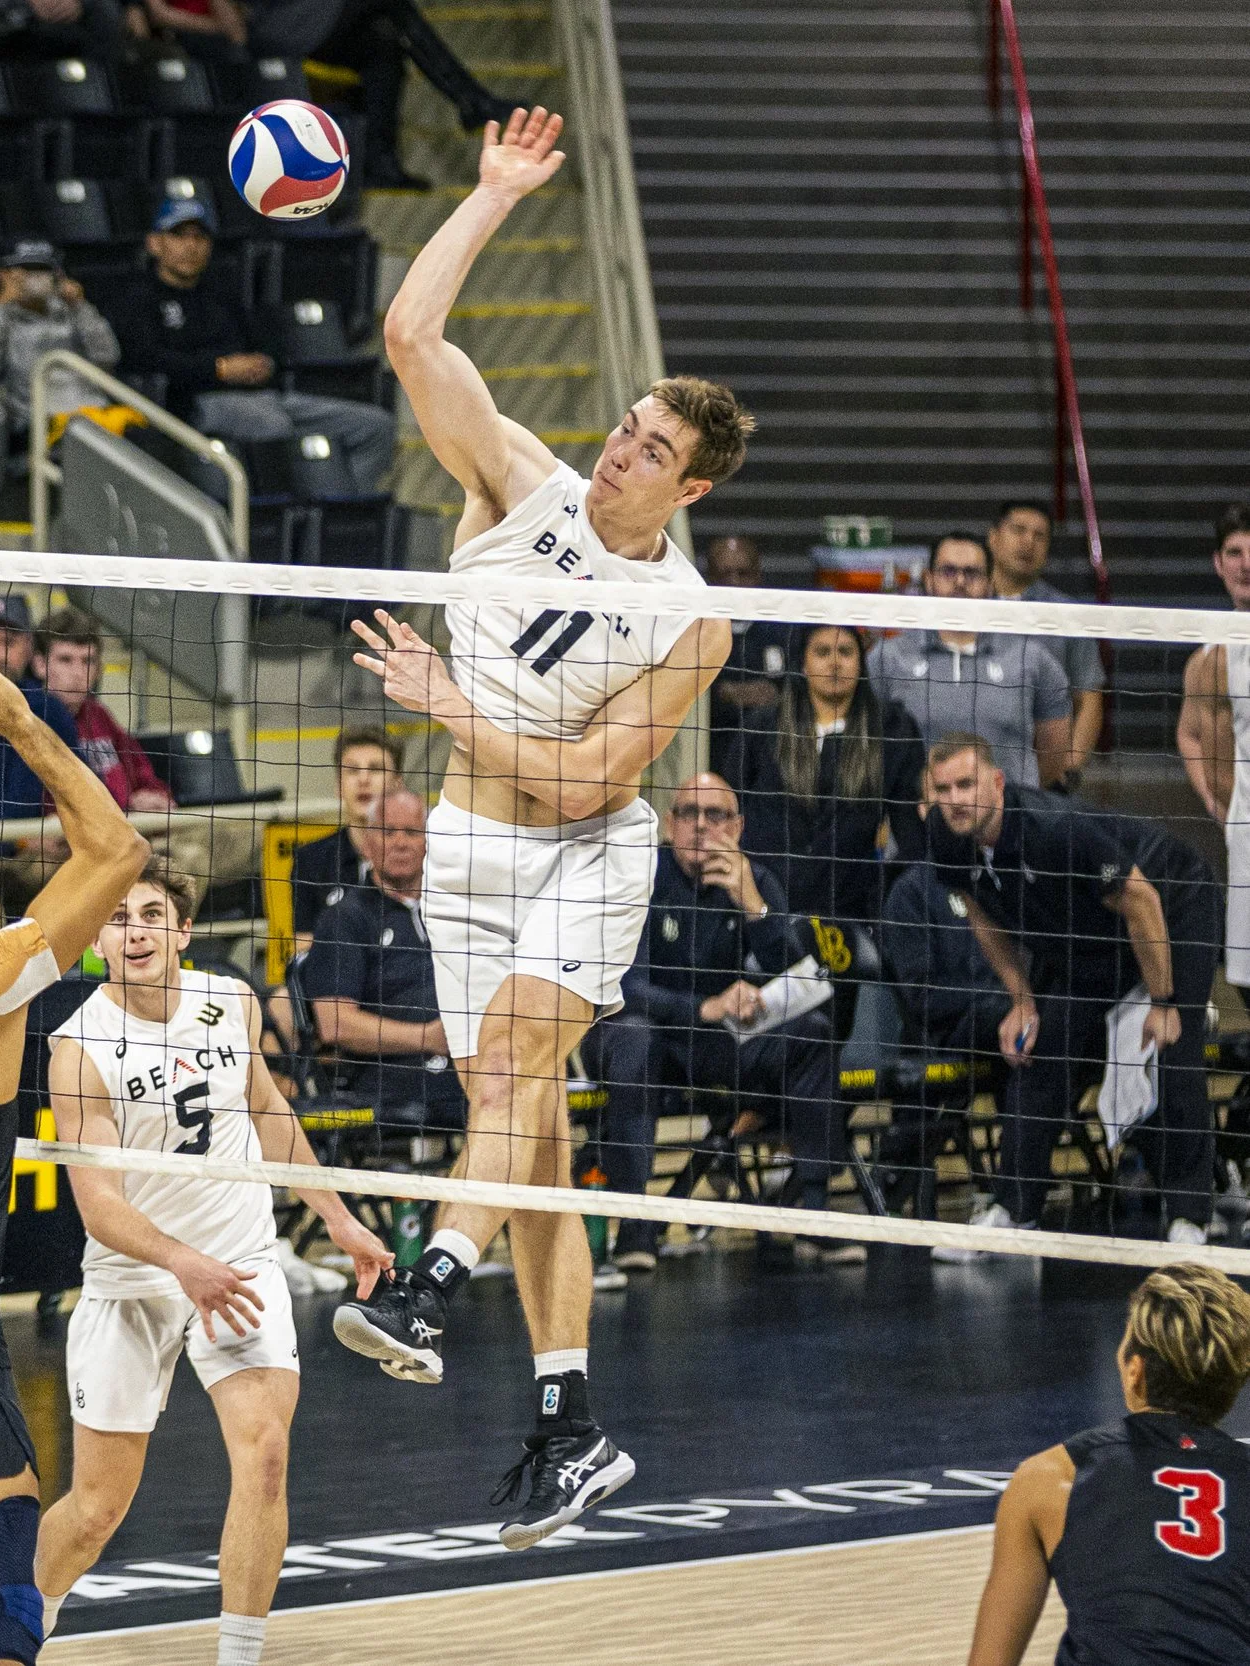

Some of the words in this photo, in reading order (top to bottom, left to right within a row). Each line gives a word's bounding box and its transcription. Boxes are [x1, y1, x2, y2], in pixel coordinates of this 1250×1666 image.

[127, 1045, 237, 1100] BEACH
[172, 1081, 215, 1155] 5
[1153, 1466, 1226, 1562] 3
